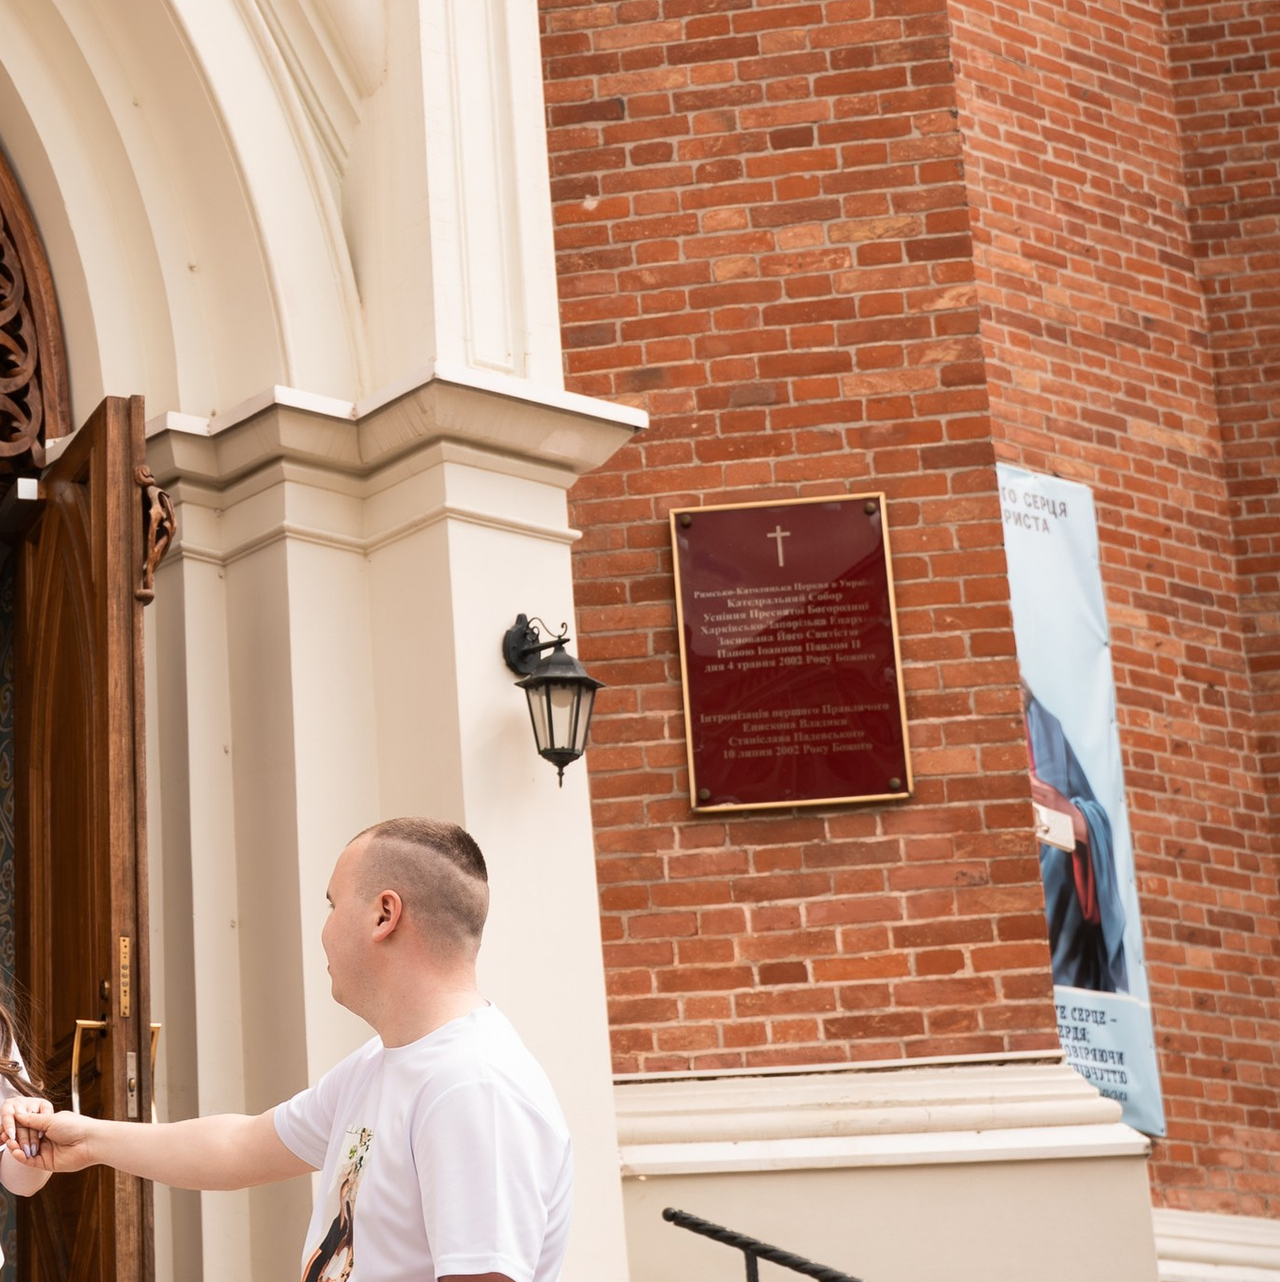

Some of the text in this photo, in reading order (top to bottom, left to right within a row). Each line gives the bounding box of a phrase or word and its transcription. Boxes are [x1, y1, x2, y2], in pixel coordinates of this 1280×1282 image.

[1023, 492, 1067, 519] СЕРЦЯ
[1003, 508, 1051, 533] РИСТА
[808, 591, 842, 602] Собор
[703, 611, 746, 623] Успіння
[777, 629, 803, 641] Його
[717, 648, 755, 659] Папою
[805, 642, 849, 652] Павлом
[704, 663, 725, 673] дня
[736, 659, 776, 671] травня
[778, 655, 803, 666] 2002
[805, 655, 831, 665] Року
[835, 653, 876, 662] Божого
[723, 749, 735, 759] 10
[775, 745, 800, 756] 2002
[803, 745, 829, 756] Року
[832, 742, 873, 752] Божого
[1071, 1007, 1106, 1026] СЕРЦЕ
[1062, 1044, 1124, 1066] ОВІРЯЮЧИ
